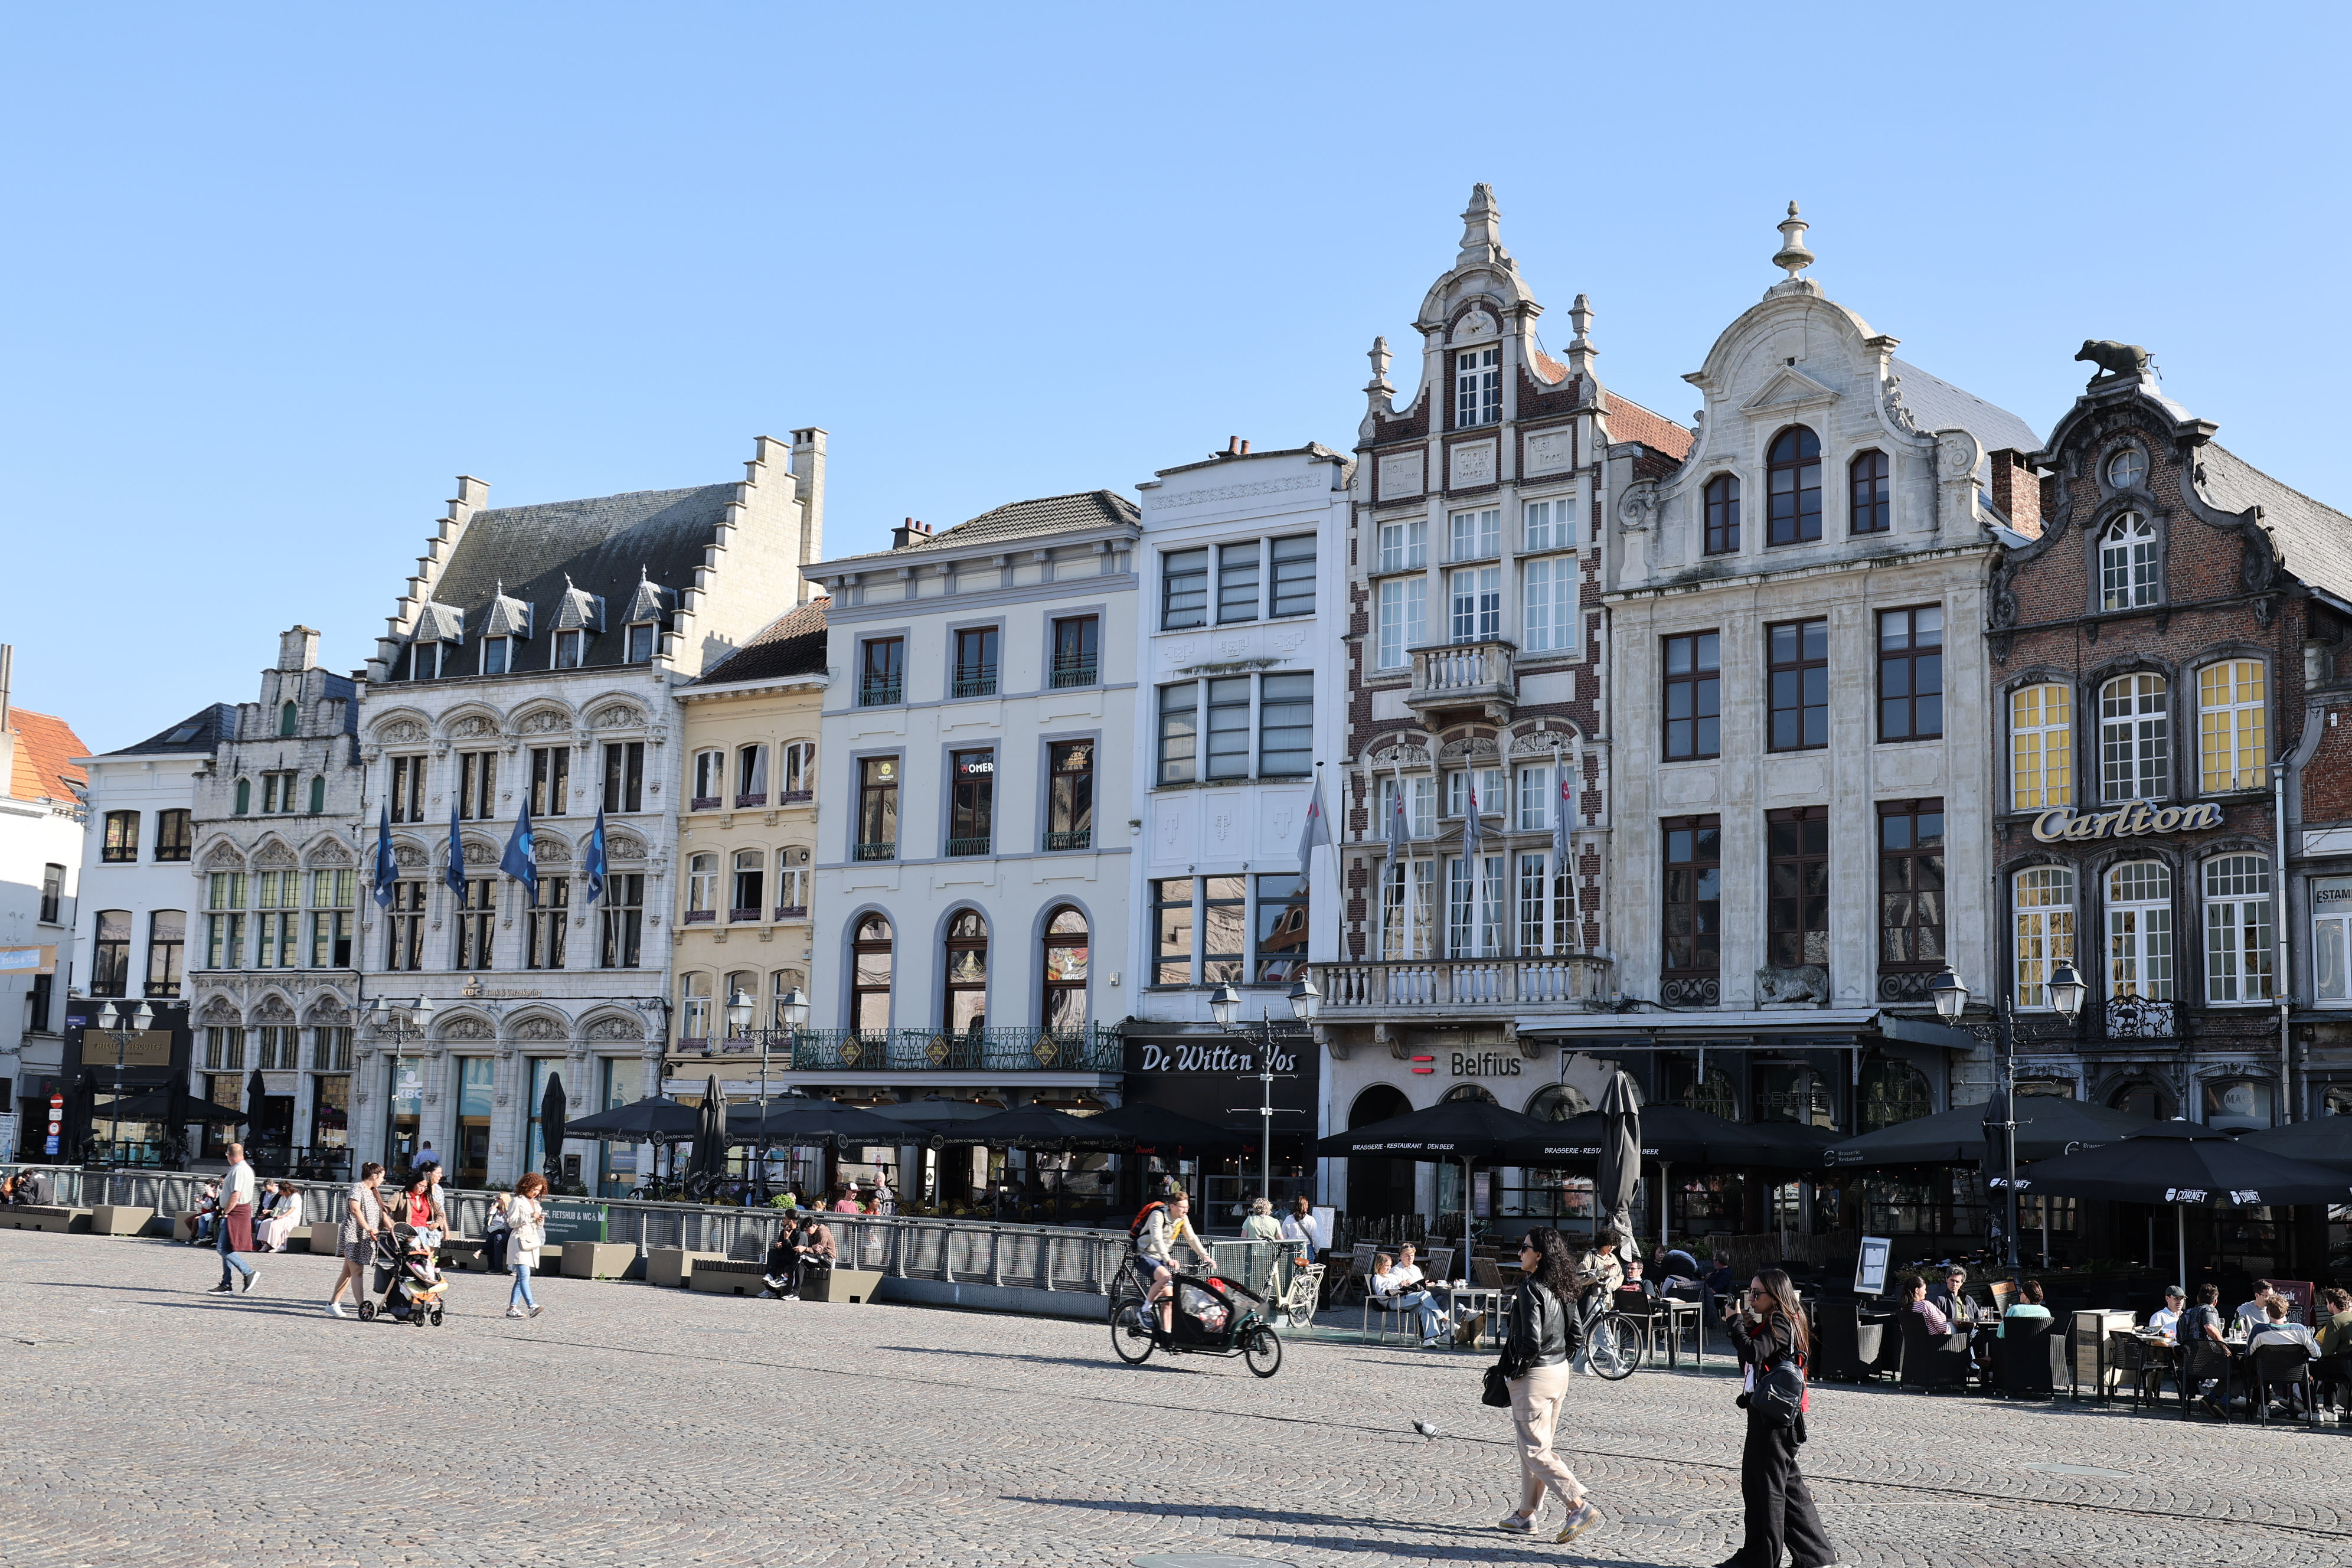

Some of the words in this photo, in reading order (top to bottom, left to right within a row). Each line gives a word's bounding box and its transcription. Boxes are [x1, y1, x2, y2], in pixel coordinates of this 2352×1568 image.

[969, 763, 994, 773] OMER
[2032, 801, 2216, 842] Carlton
[2317, 888, 2352, 903] ESTAM
[1142, 1044, 1171, 1072] De
[1175, 1044, 1253, 1071] Witten
[1259, 1044, 1296, 1071] Vos
[1452, 1052, 1520, 1076] Belfius
[397, 1089, 422, 1099] KBC
[1135, 1145, 1155, 1154] Duvel
[2000, 1180, 2031, 1189] CNET
[2176, 1190, 2208, 1203] CORNET
[2239, 1191, 2261, 1203] CORNET
[552, 1210, 576, 1220] FIETSHUB
[577, 1211, 582, 1220] &
[583, 1212, 592, 1221] WC
